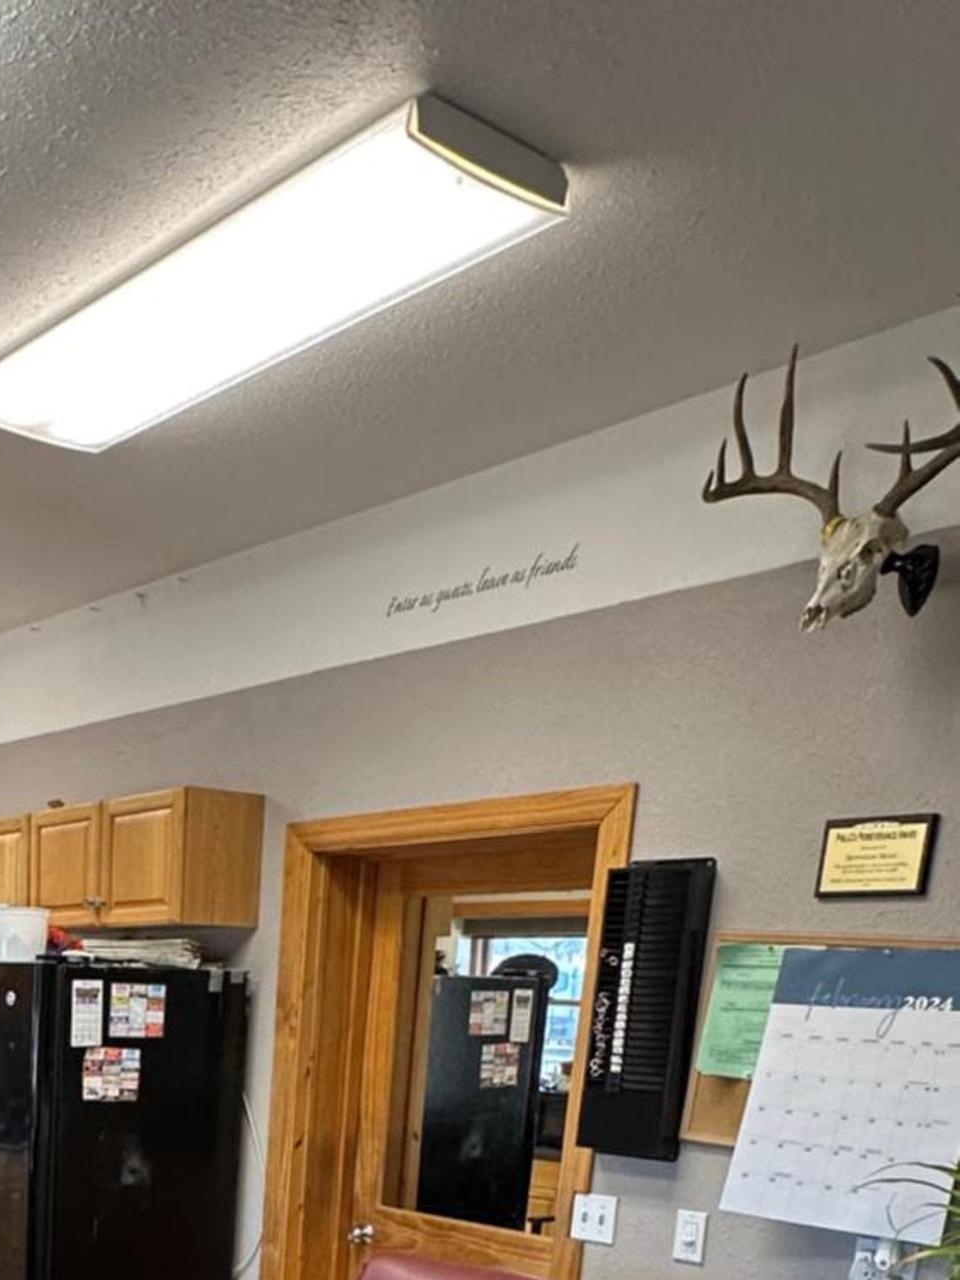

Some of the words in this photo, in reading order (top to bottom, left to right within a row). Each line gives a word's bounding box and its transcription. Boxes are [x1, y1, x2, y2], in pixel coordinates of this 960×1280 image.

[386, 596, 419, 618] Enter
[419, 593, 432, 607] as
[476, 565, 509, 594] leave
[509, 568, 527, 584] as
[526, 542, 580, 589] friends
[902, 995, 955, 1011] 2024
